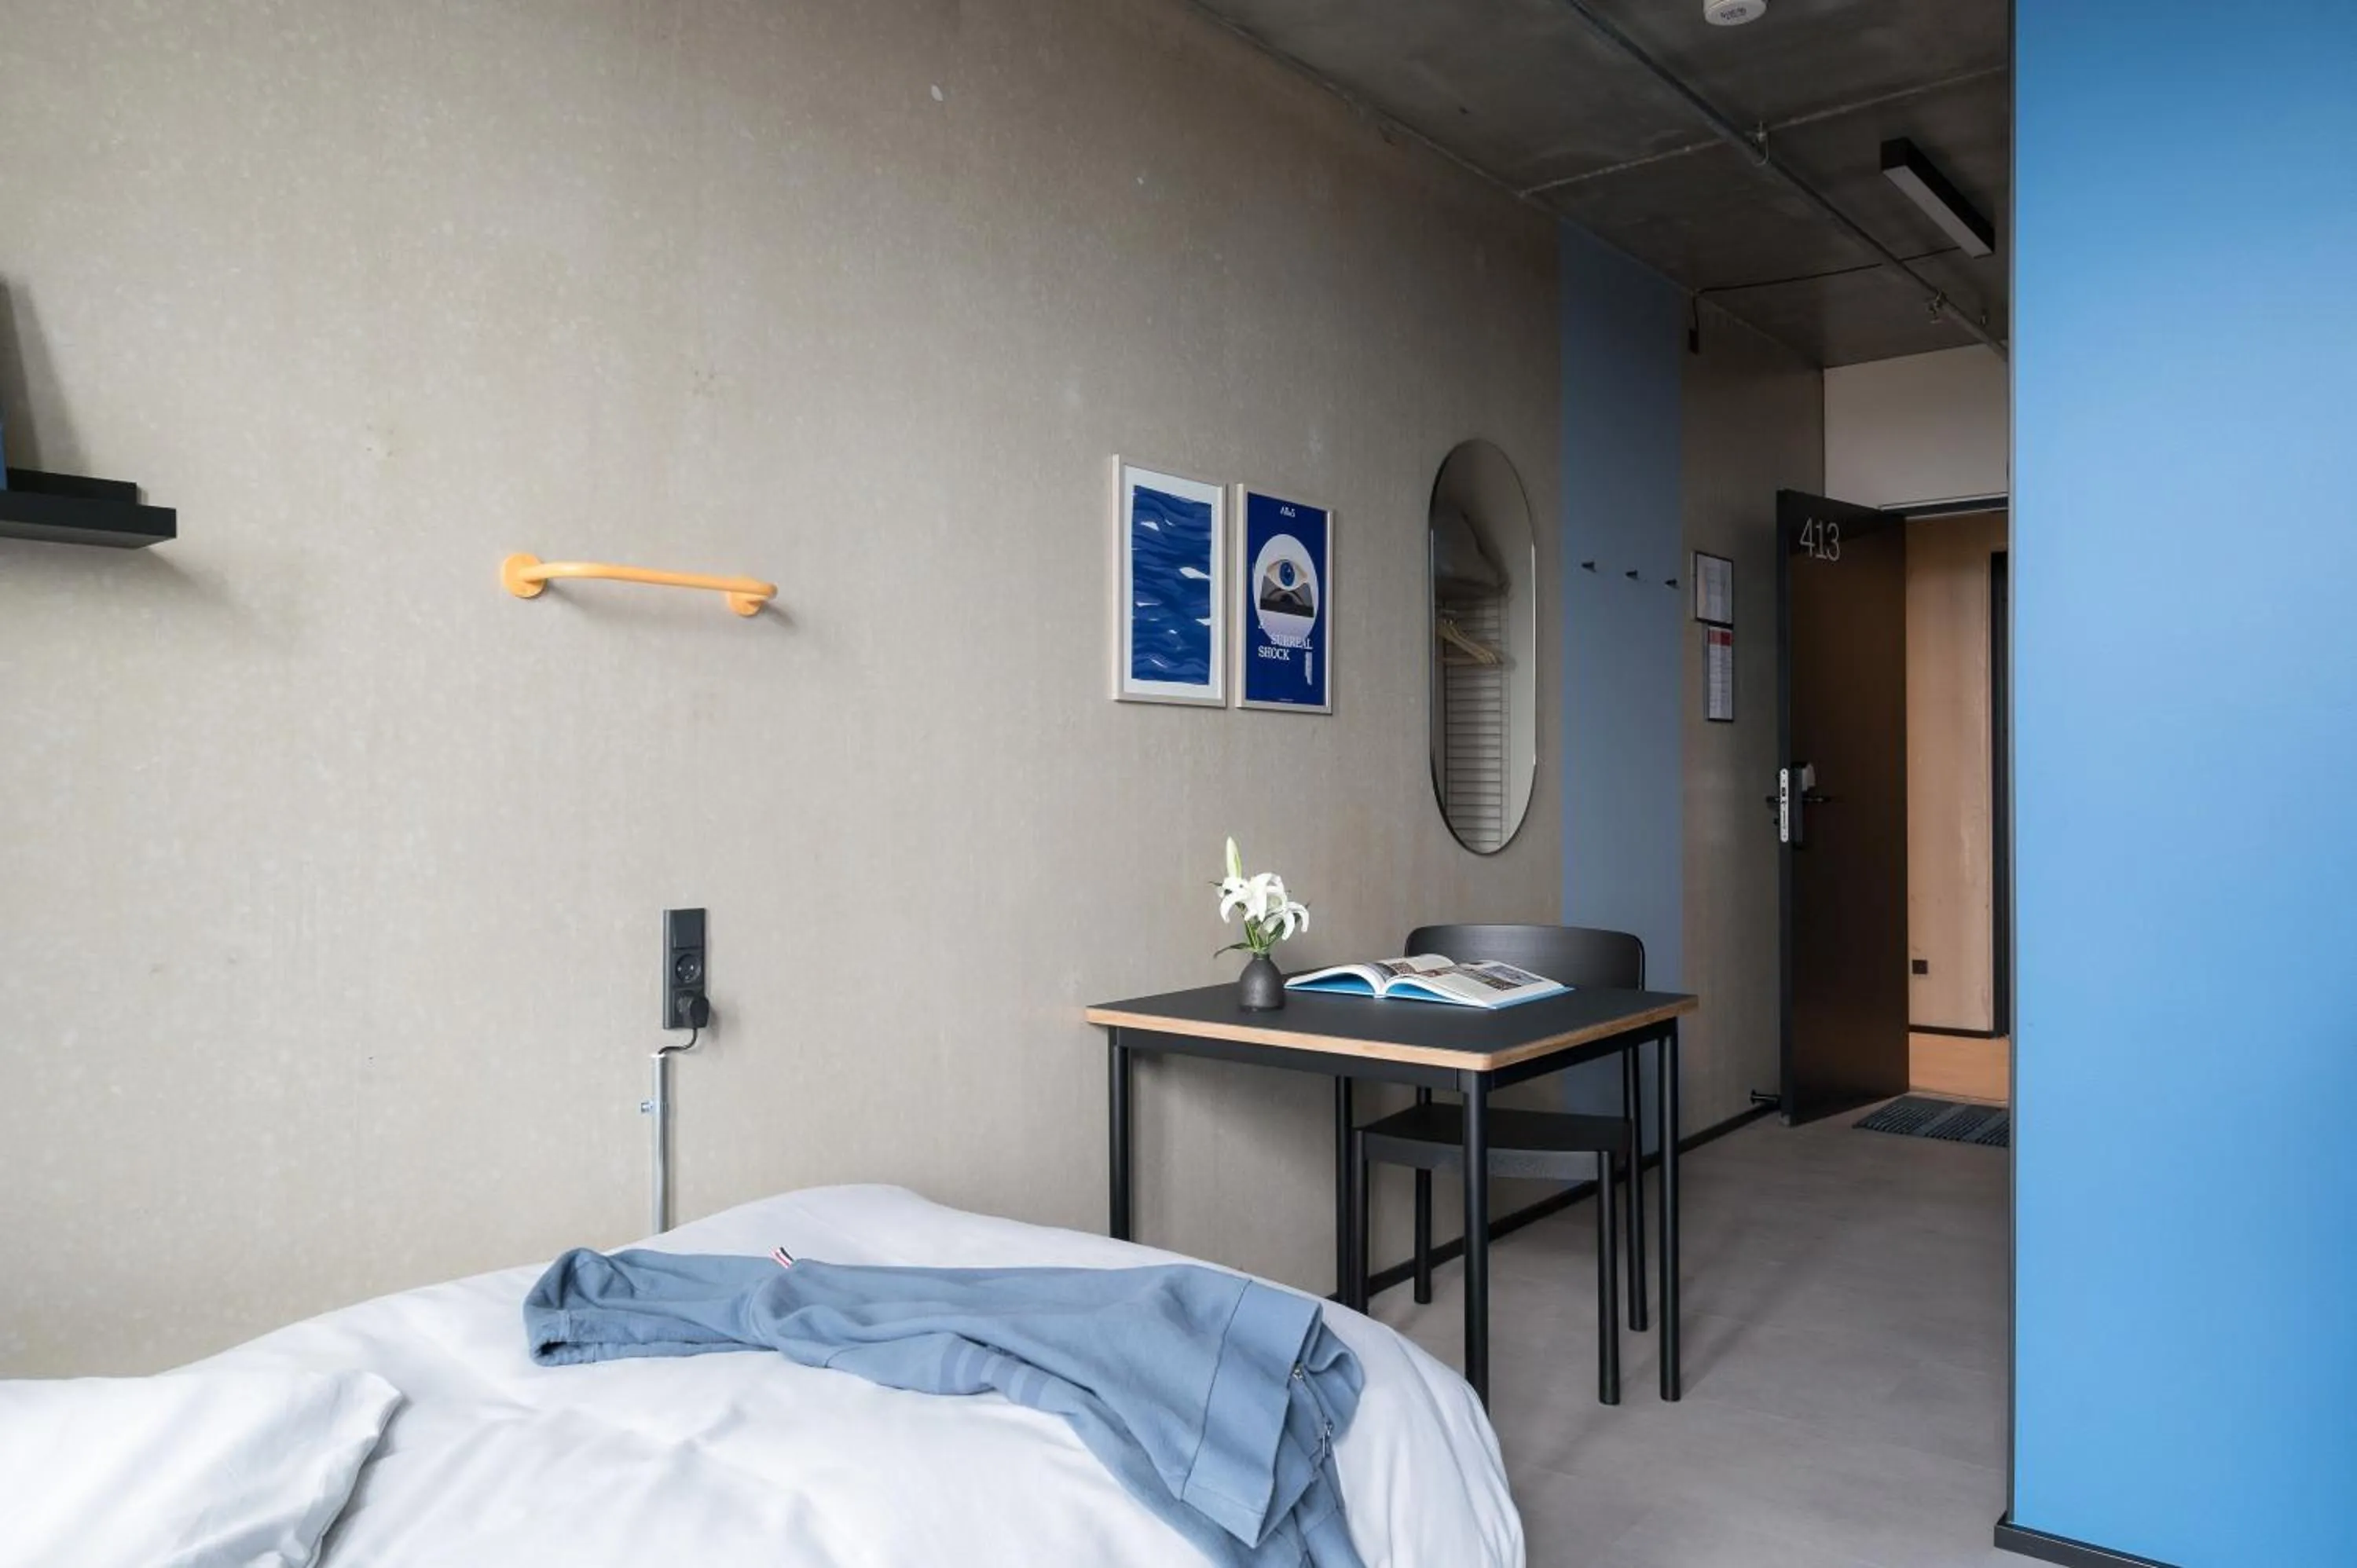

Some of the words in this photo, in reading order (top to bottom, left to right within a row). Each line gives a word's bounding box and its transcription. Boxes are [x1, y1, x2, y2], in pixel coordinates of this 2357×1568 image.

[1799, 517, 1840, 562] 413
[1270, 634, 1313, 650] SURREAL
[1258, 645, 1290, 661] SHOCK
